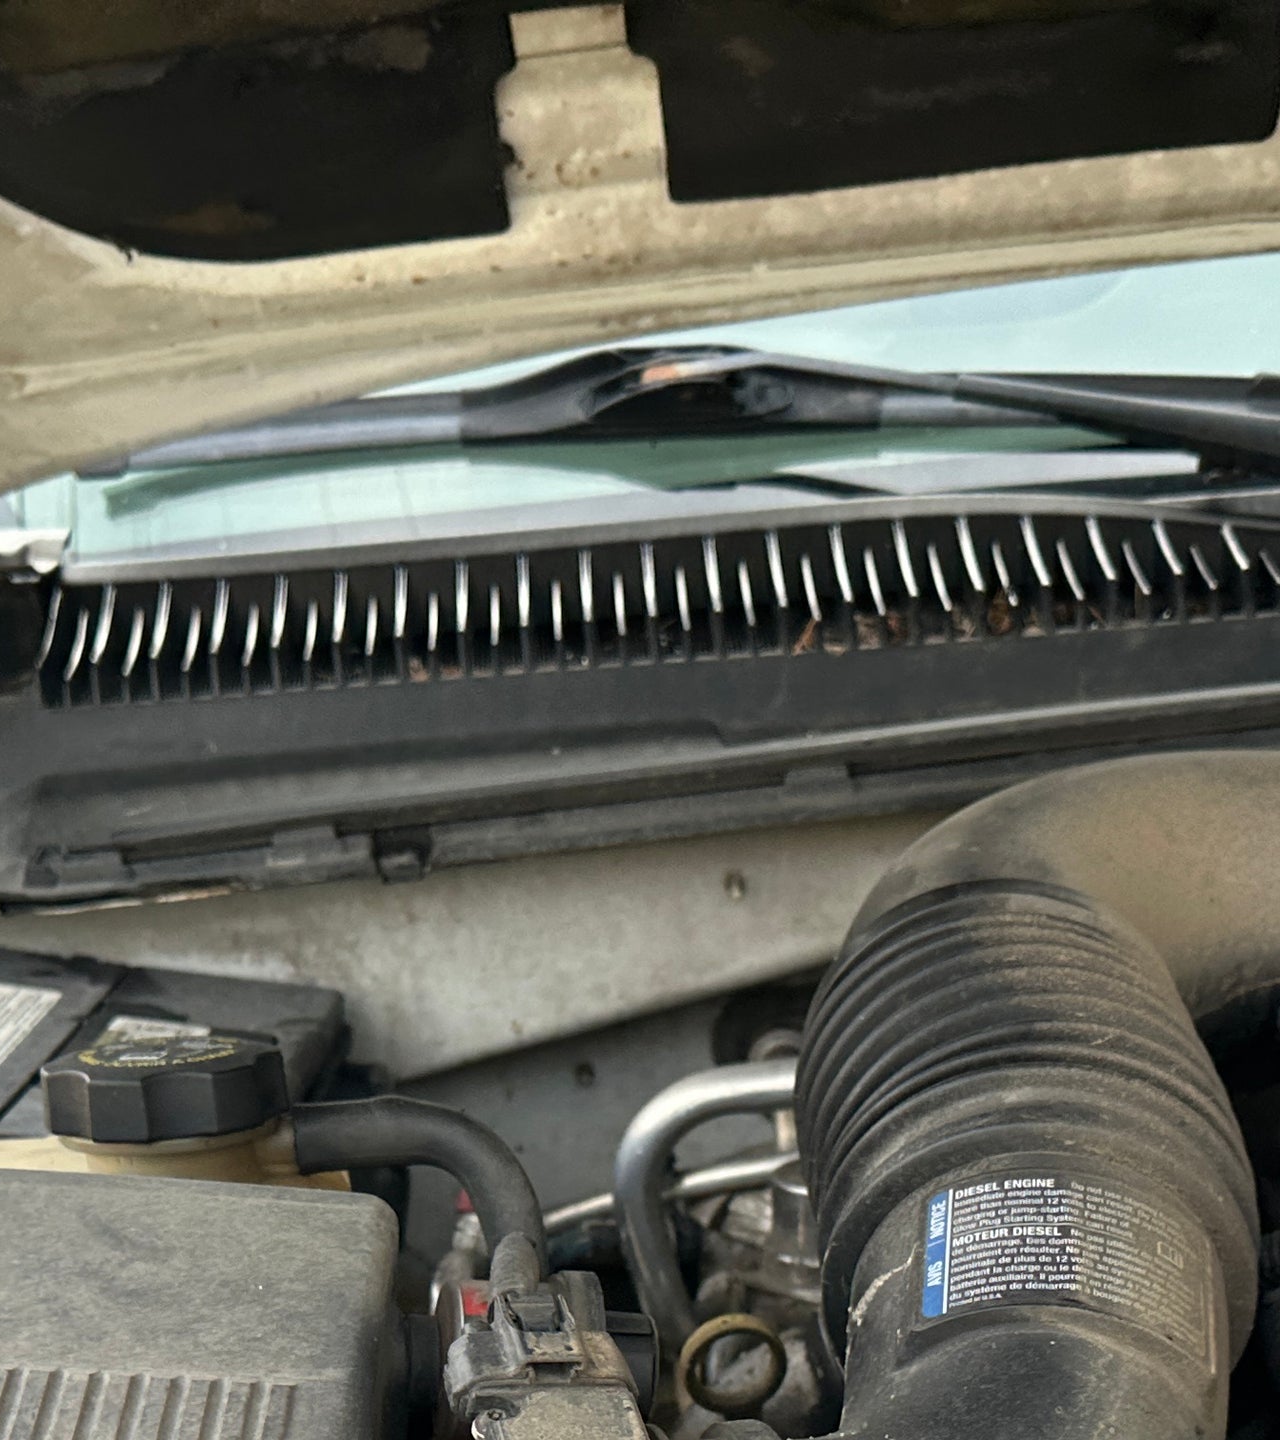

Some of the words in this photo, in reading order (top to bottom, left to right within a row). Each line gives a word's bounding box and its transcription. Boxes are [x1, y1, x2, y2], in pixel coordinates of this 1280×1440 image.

[954, 1182, 1001, 1200] DIESEL
[1003, 1178, 1056, 1190] ENGINE
[1007, 1188, 1042, 1198] engine
[1047, 1197, 1059, 1205] 12
[929, 1200, 947, 1240] NOTICE
[952, 1227, 1010, 1247] MOTEUR
[1012, 1225, 1063, 1237] DIESEL
[1055, 1255, 1068, 1263] 12
[927, 1260, 944, 1288] AVIS
[949, 1267, 991, 1284] pendant
[992, 1263, 1003, 1274] la
[1004, 1264, 1042, 1275] charge
[1042, 1264, 1058, 1273] ou
[1059, 1264, 1071, 1273] le
